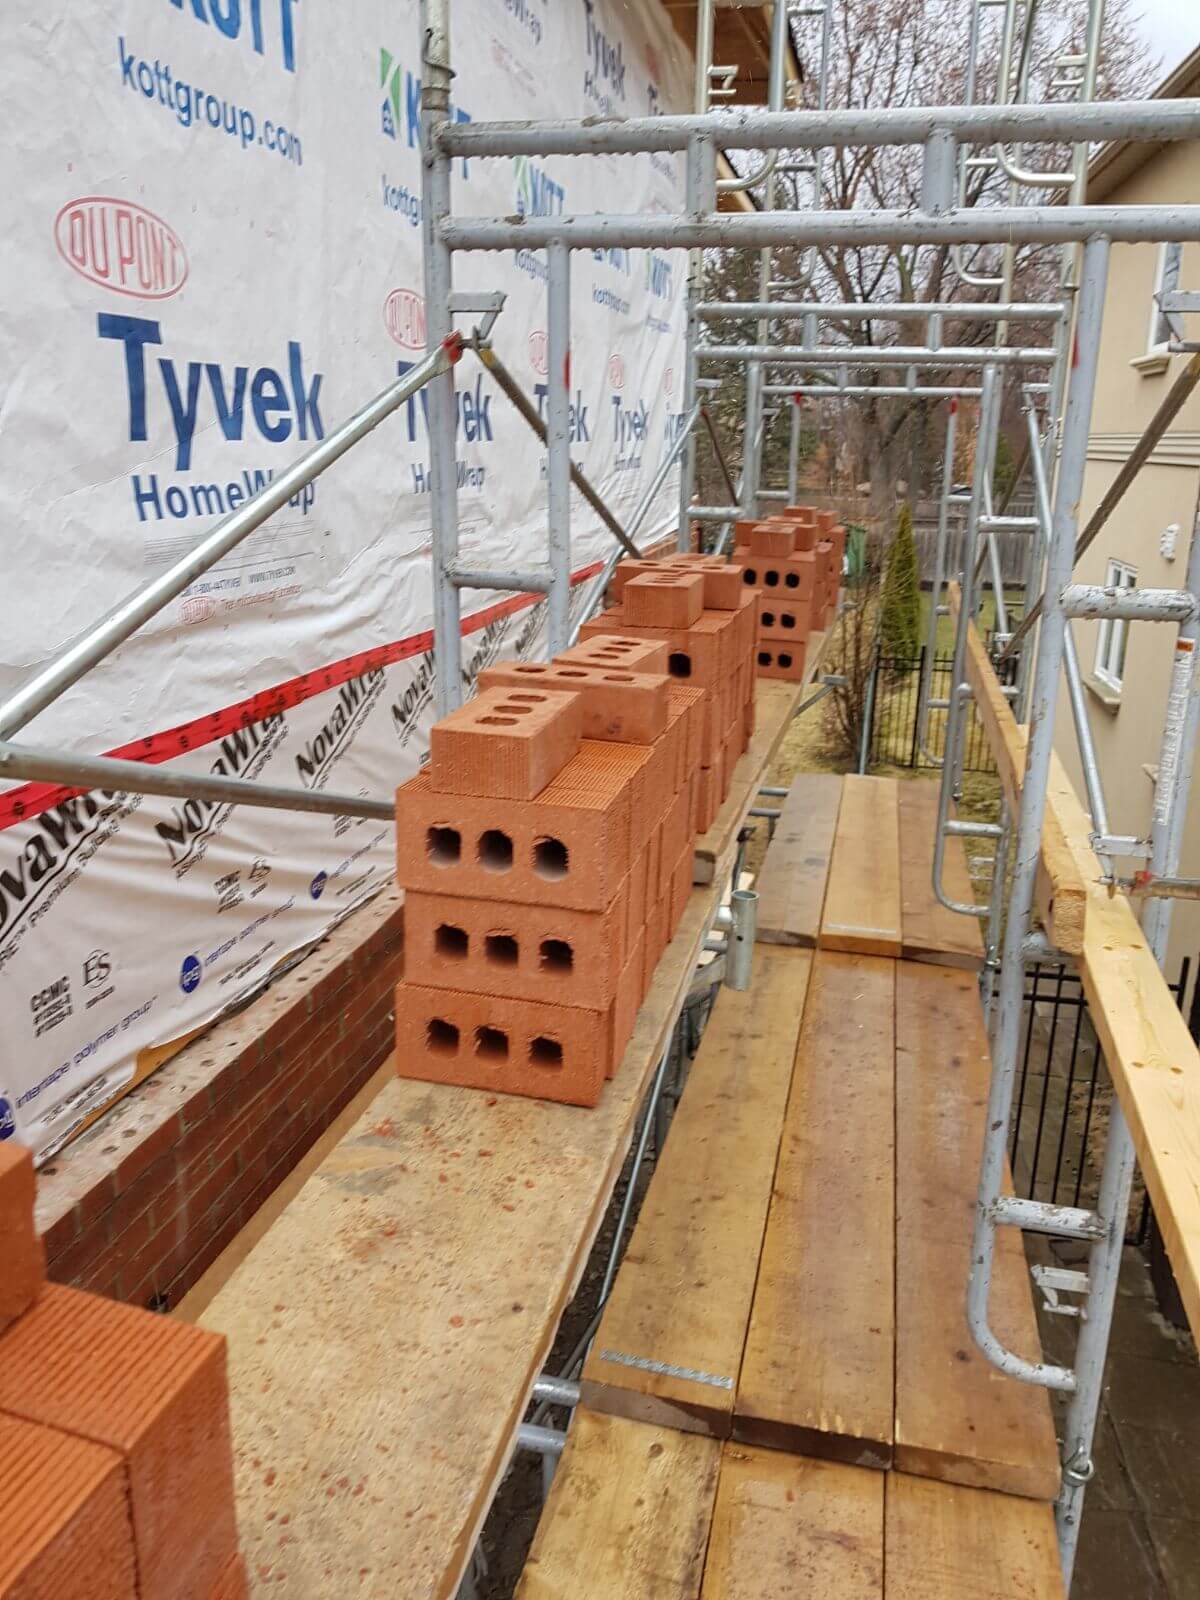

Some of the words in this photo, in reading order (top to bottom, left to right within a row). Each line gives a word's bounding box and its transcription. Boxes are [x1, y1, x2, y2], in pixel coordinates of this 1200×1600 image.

[97, 311, 324, 472] Tyvek
[397, 359, 494, 442] Tek
[132, 469, 316, 522] HomeWap
[411, 460, 485, 494] HWrap
